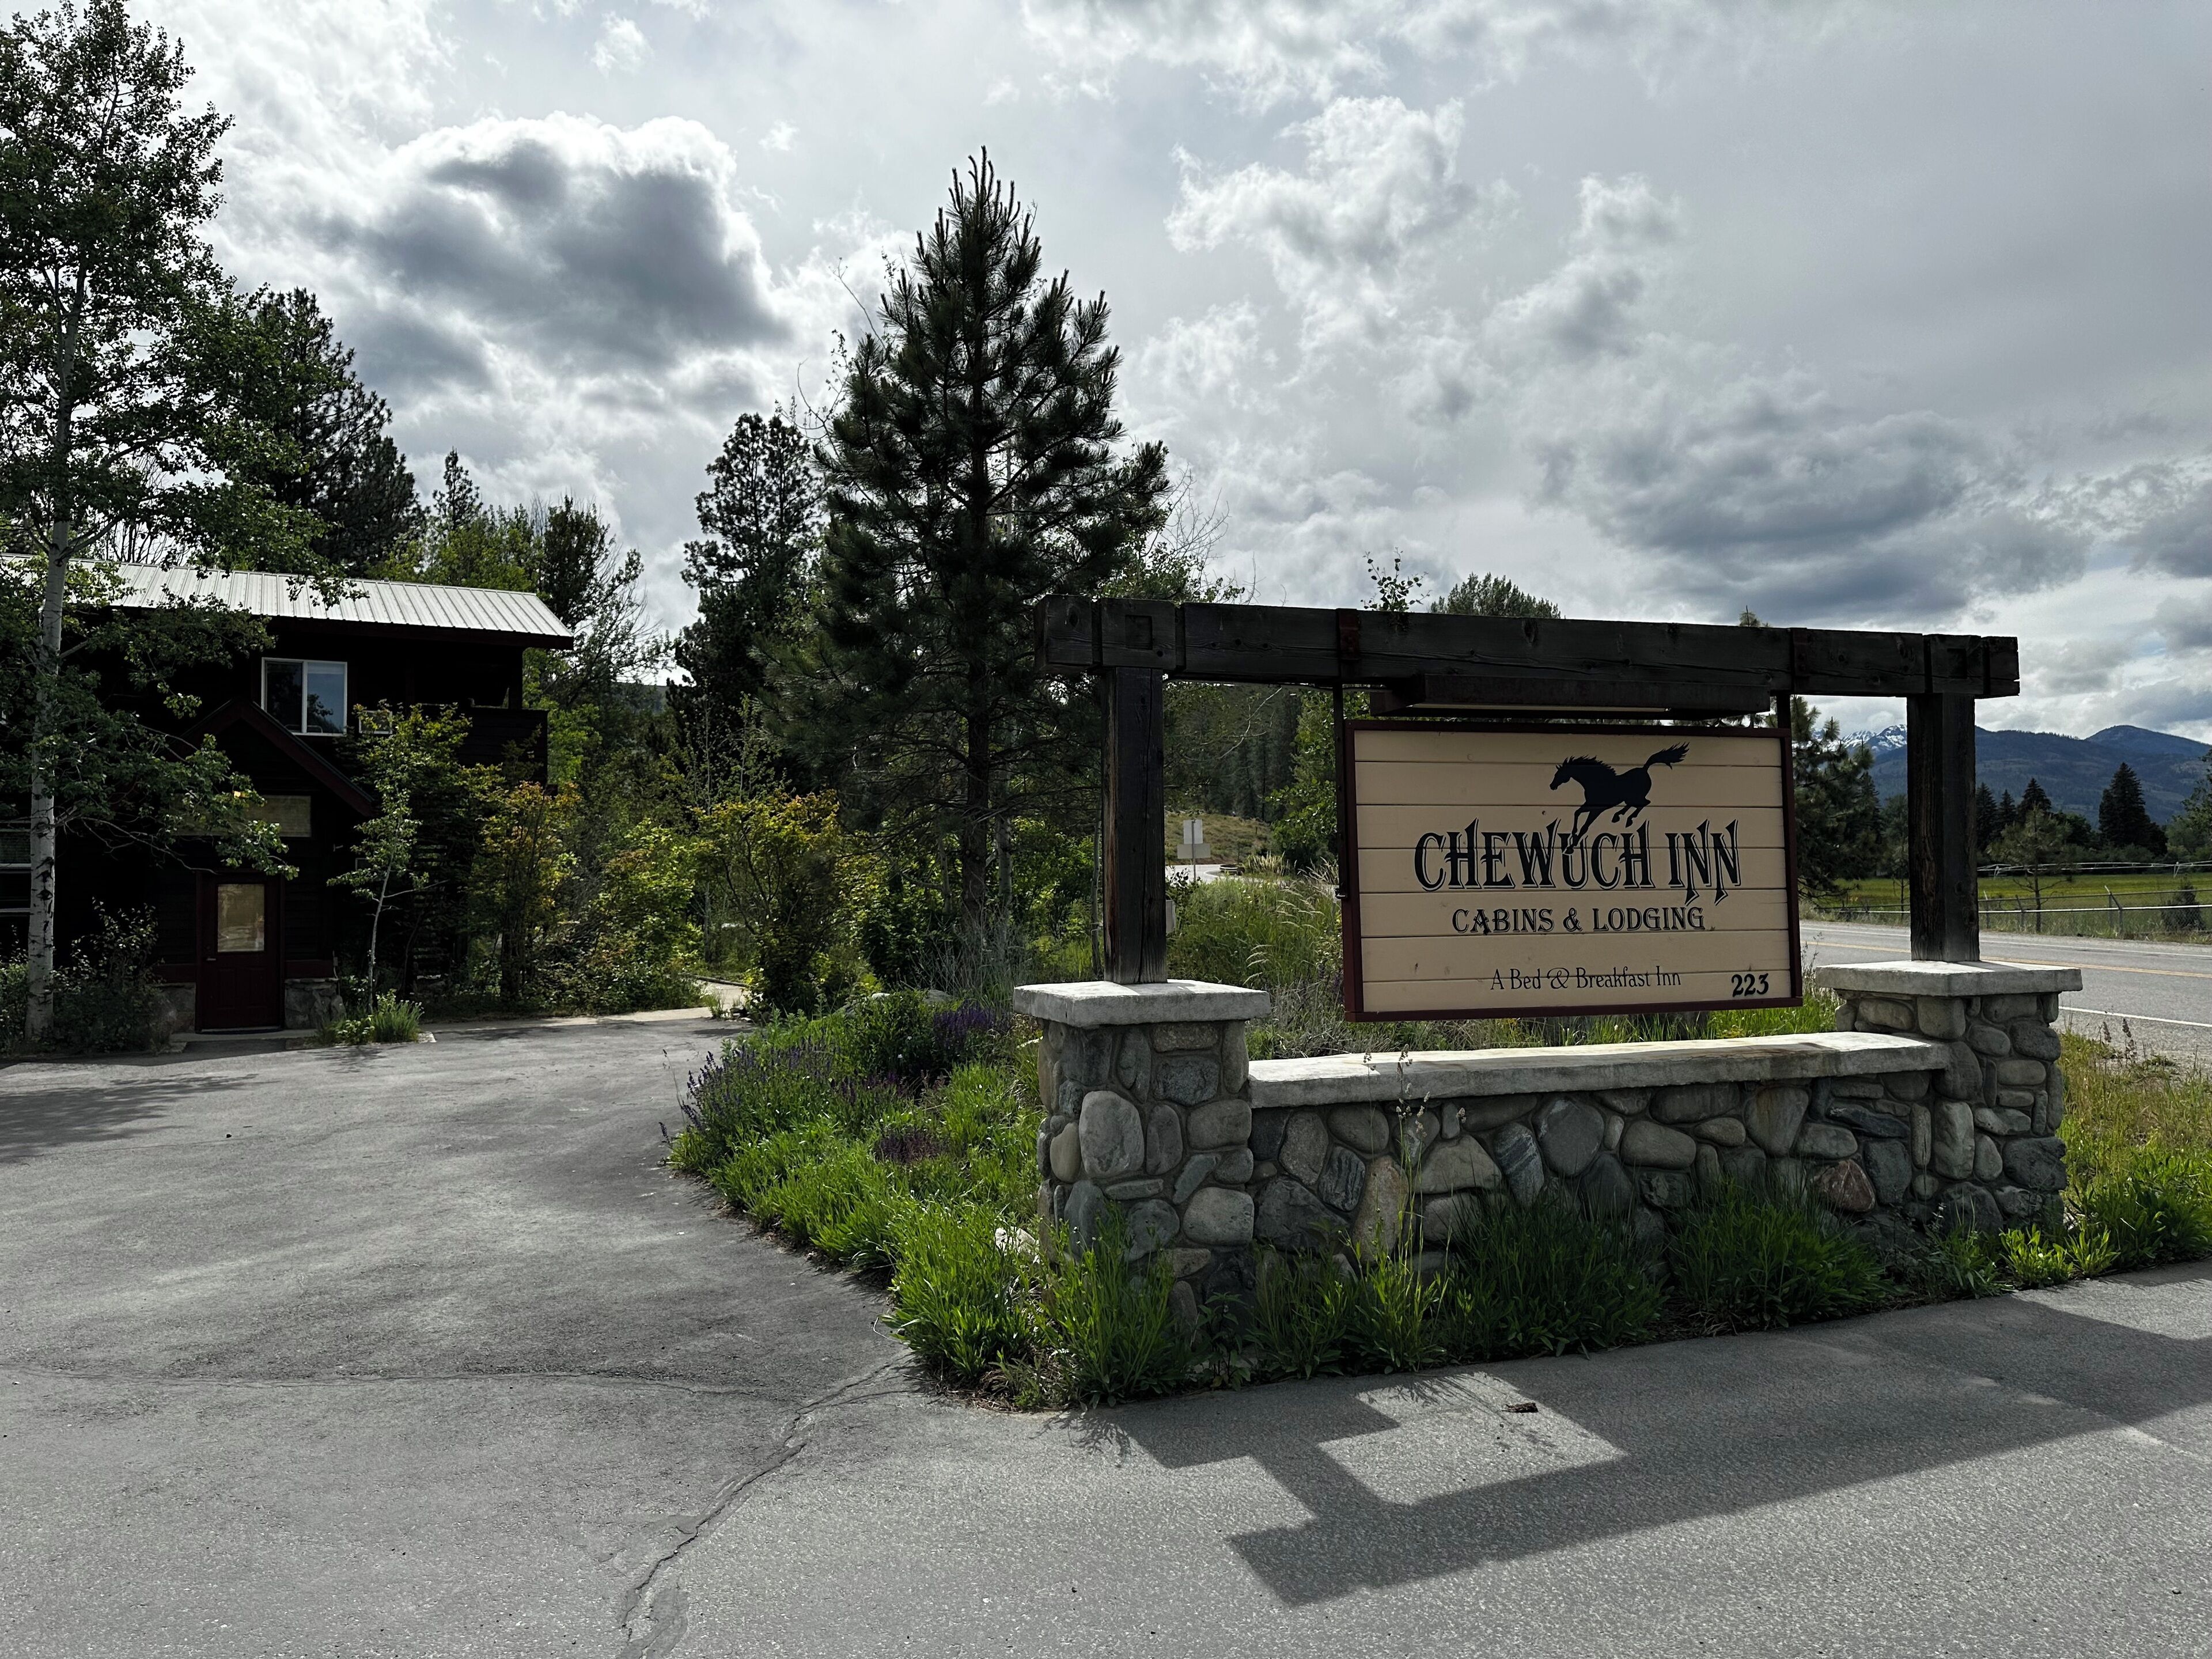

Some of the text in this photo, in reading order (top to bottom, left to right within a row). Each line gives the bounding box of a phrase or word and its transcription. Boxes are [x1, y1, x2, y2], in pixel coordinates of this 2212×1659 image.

[1415, 818, 1741, 906] CHEWUCH INN
[1452, 906, 1706, 934] CABINS & LODGING
[1490, 965, 1681, 990] A Bed & Breakfast Inn
[1731, 973, 1770, 997] 223
